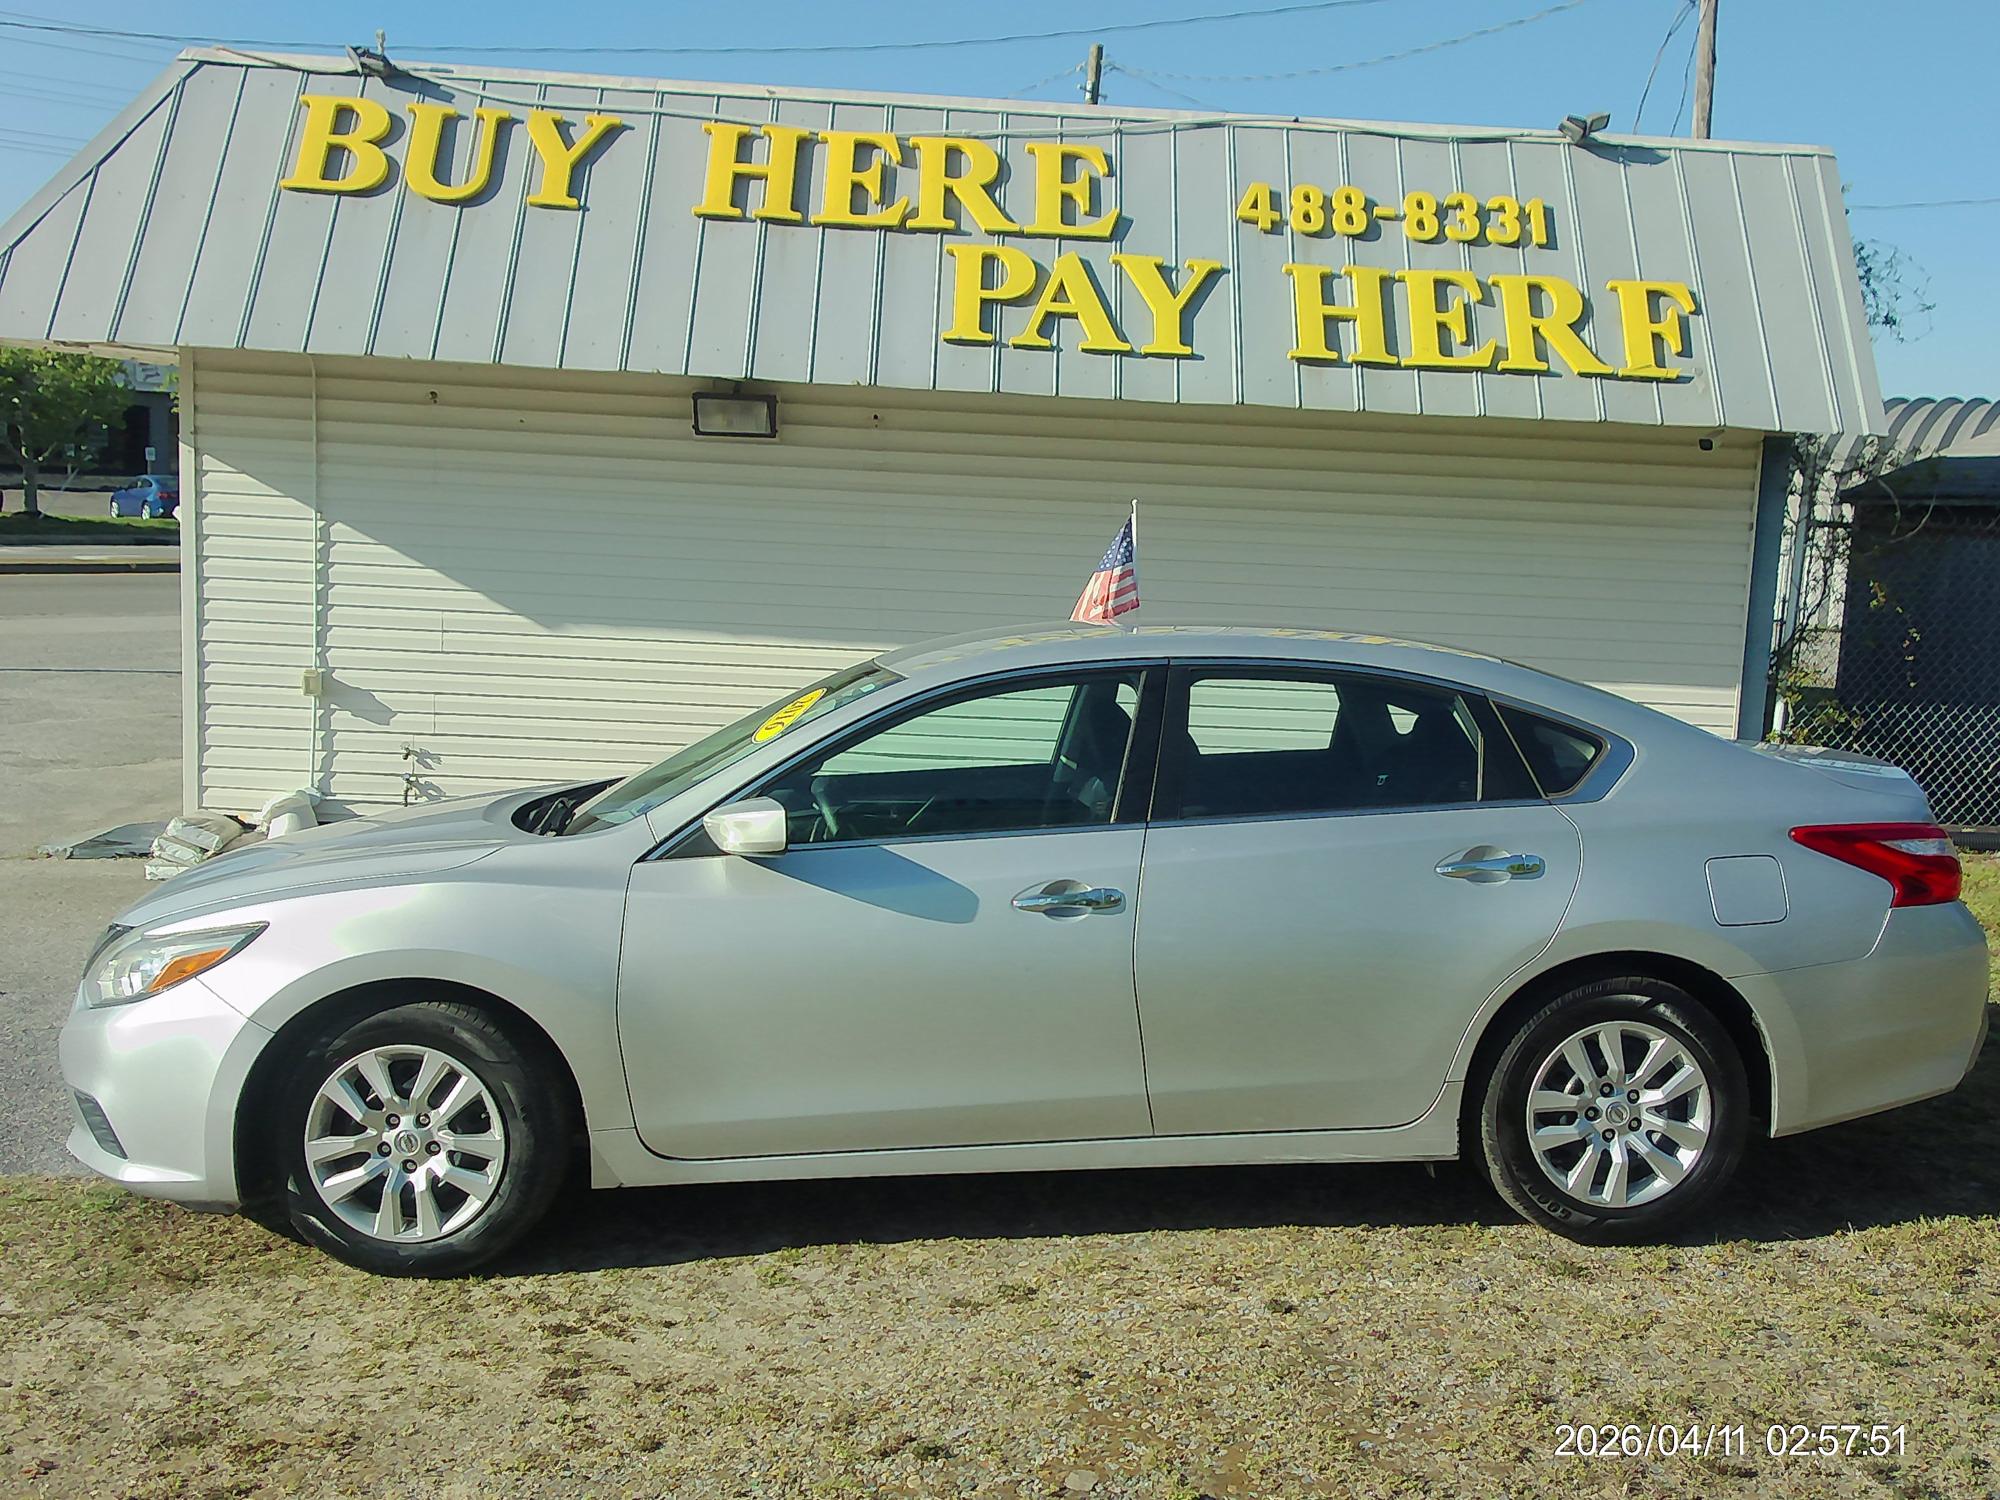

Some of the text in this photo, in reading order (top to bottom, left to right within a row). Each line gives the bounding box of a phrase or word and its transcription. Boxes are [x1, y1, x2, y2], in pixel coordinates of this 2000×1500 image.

[280, 94, 1120, 239] BUY HERE
[1237, 182, 1550, 247] 488-8331
[941, 243, 1223, 356] PAY
